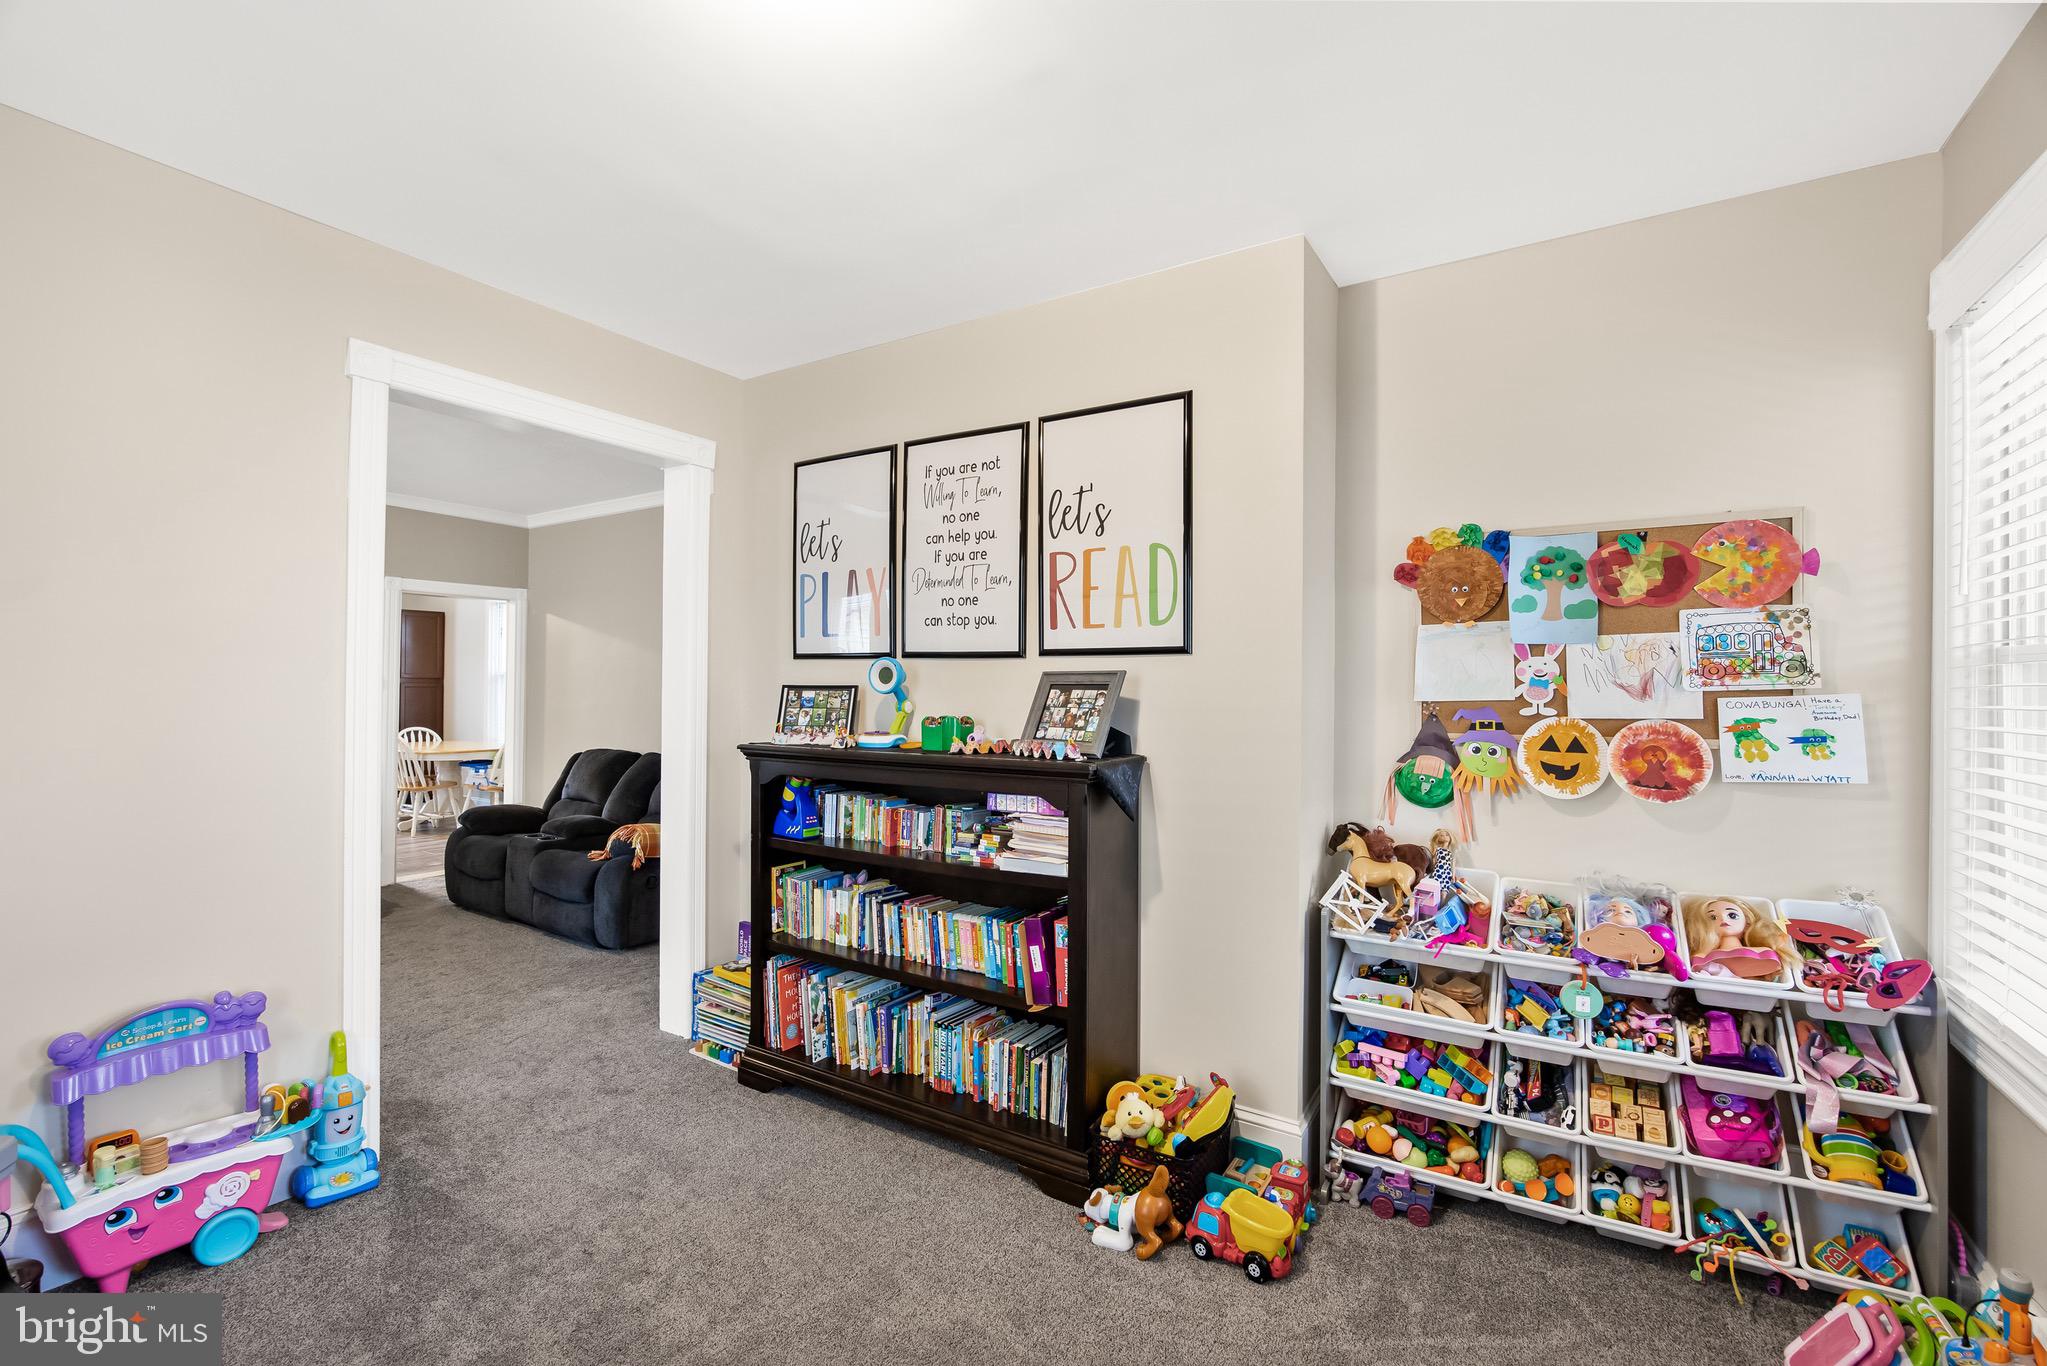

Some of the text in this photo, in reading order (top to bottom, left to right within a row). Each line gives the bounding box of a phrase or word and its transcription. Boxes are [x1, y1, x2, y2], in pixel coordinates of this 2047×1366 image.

[925, 455, 1001, 482] If you are not
[923, 476, 1002, 511] Willing To Learn,
[942, 511, 980, 524] no one
[1048, 482, 1112, 539] let's
[800, 517, 843, 564] let's
[925, 528, 997, 546] can help you.
[934, 549, 987, 567] If you are
[985, 564, 1012, 591] Learn,
[1049, 542, 1178, 630] READ
[800, 567, 887, 638] PLAY
[941, 596, 979, 607] no one
[924, 612, 997, 630] can stop you.
[1725, 699, 1807, 711] COWABUNGA!
[1810, 696, 1833, 704] Have
[1810, 774, 1852, 783] WYATT
[105, 1040, 123, 1051] Ice
[125, 1029, 165, 1045] Cream
[167, 1023, 193, 1035] Cart
